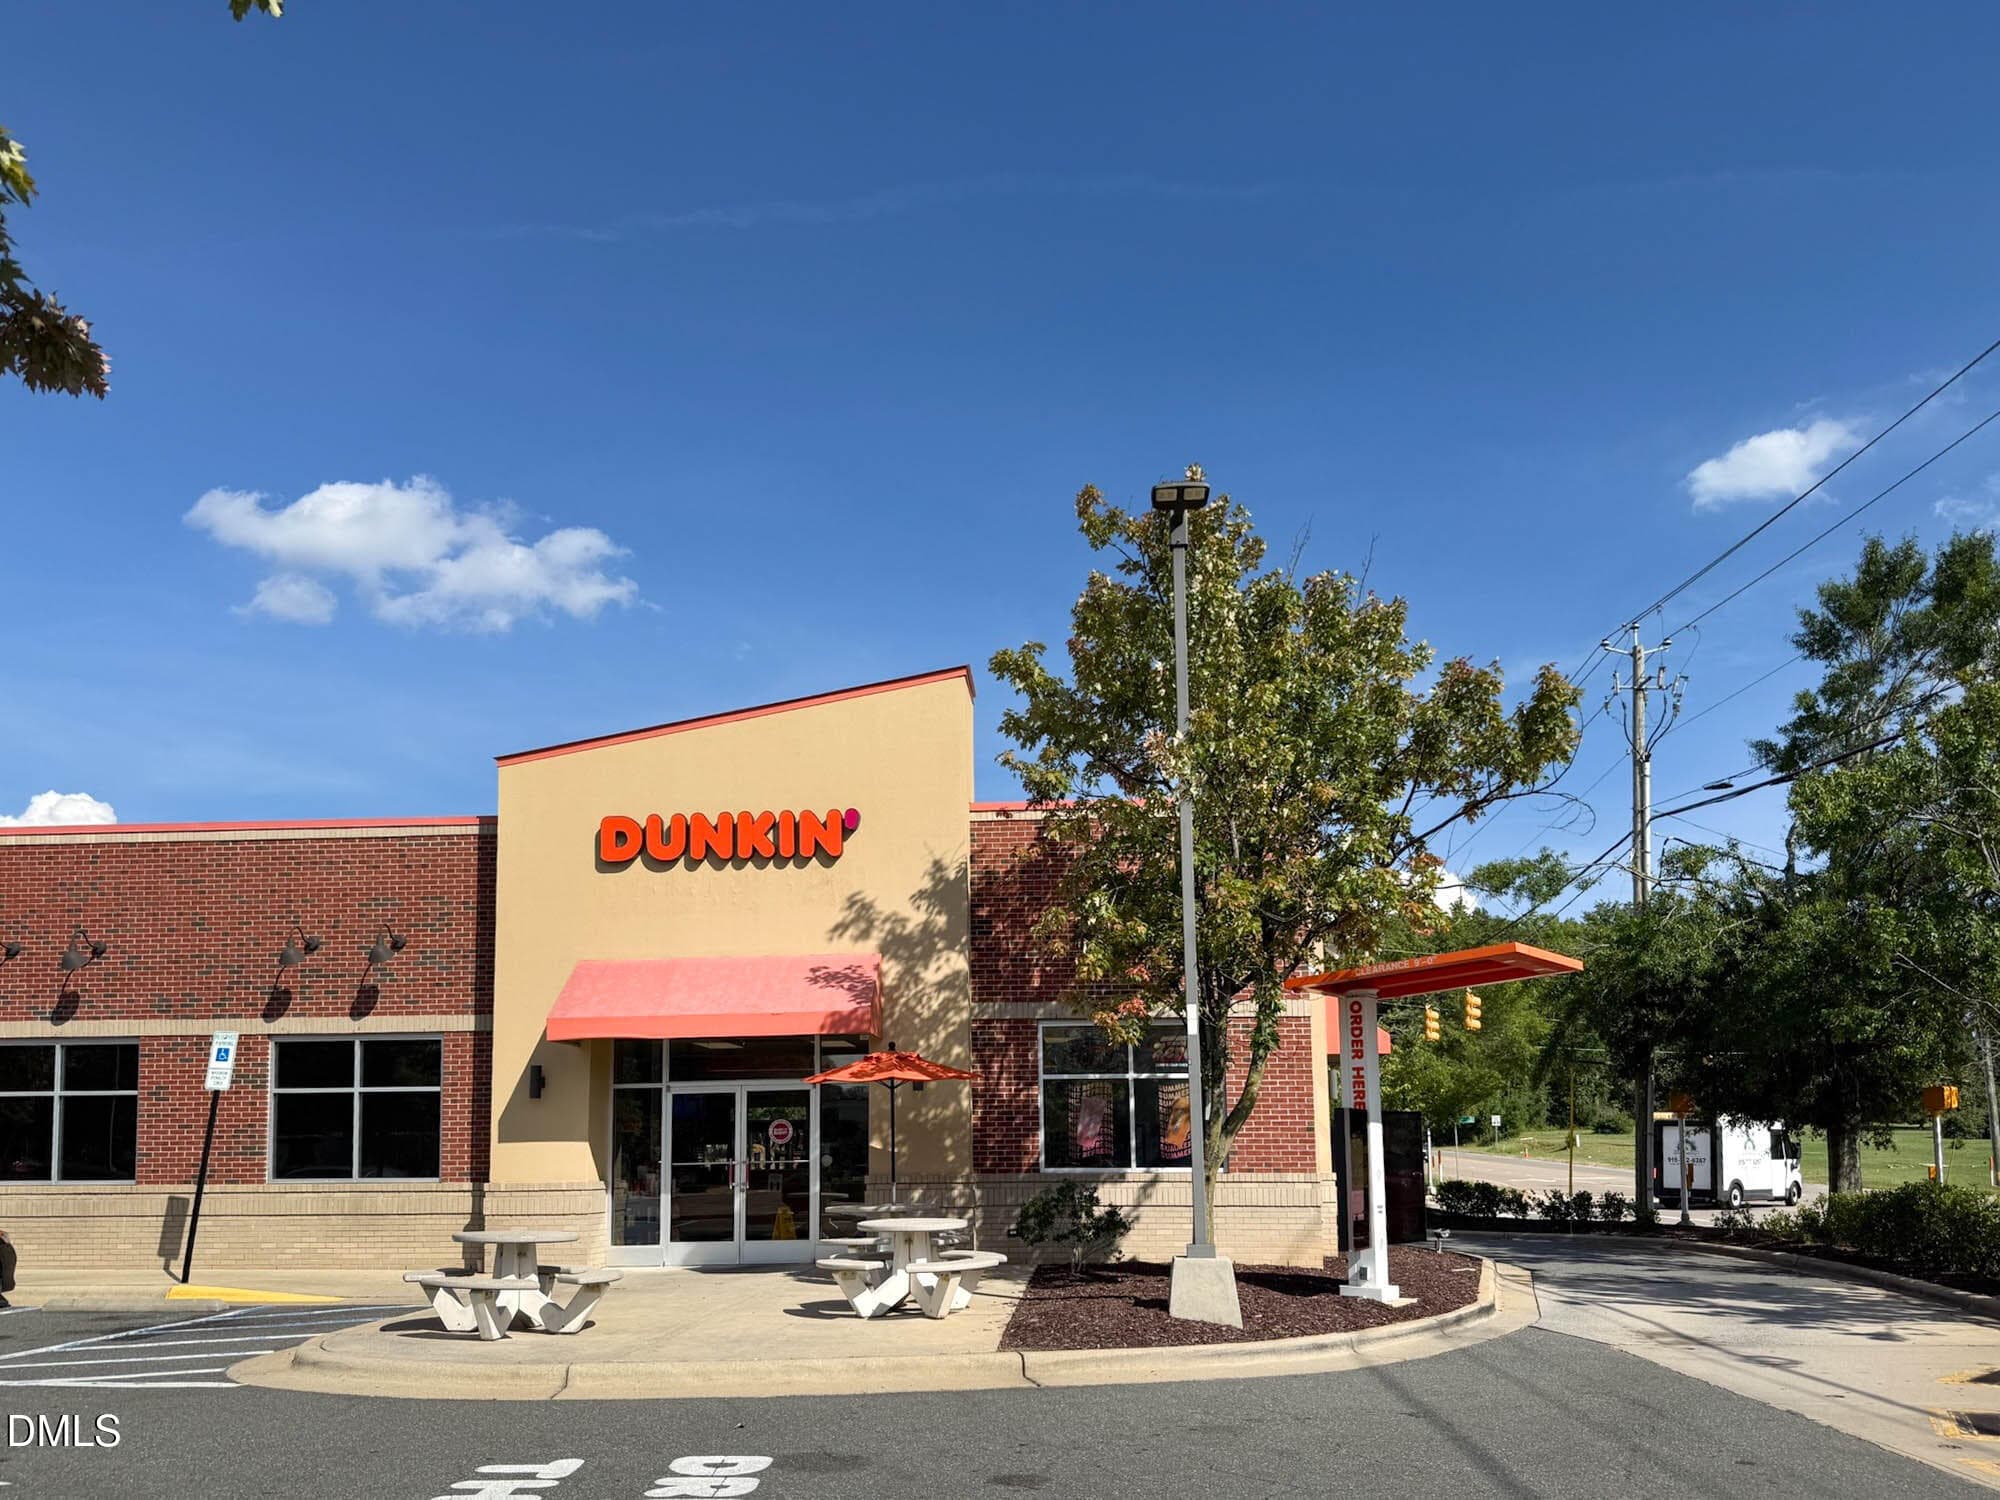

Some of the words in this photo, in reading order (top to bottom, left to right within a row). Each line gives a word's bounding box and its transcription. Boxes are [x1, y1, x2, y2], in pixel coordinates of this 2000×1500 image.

[600, 808, 860, 862] DUNKIN'
[1354, 960, 1410, 976] CLEARANCE
[1350, 1000, 1365, 1060] ORDER
[1352, 1066, 1367, 1110] HERE
